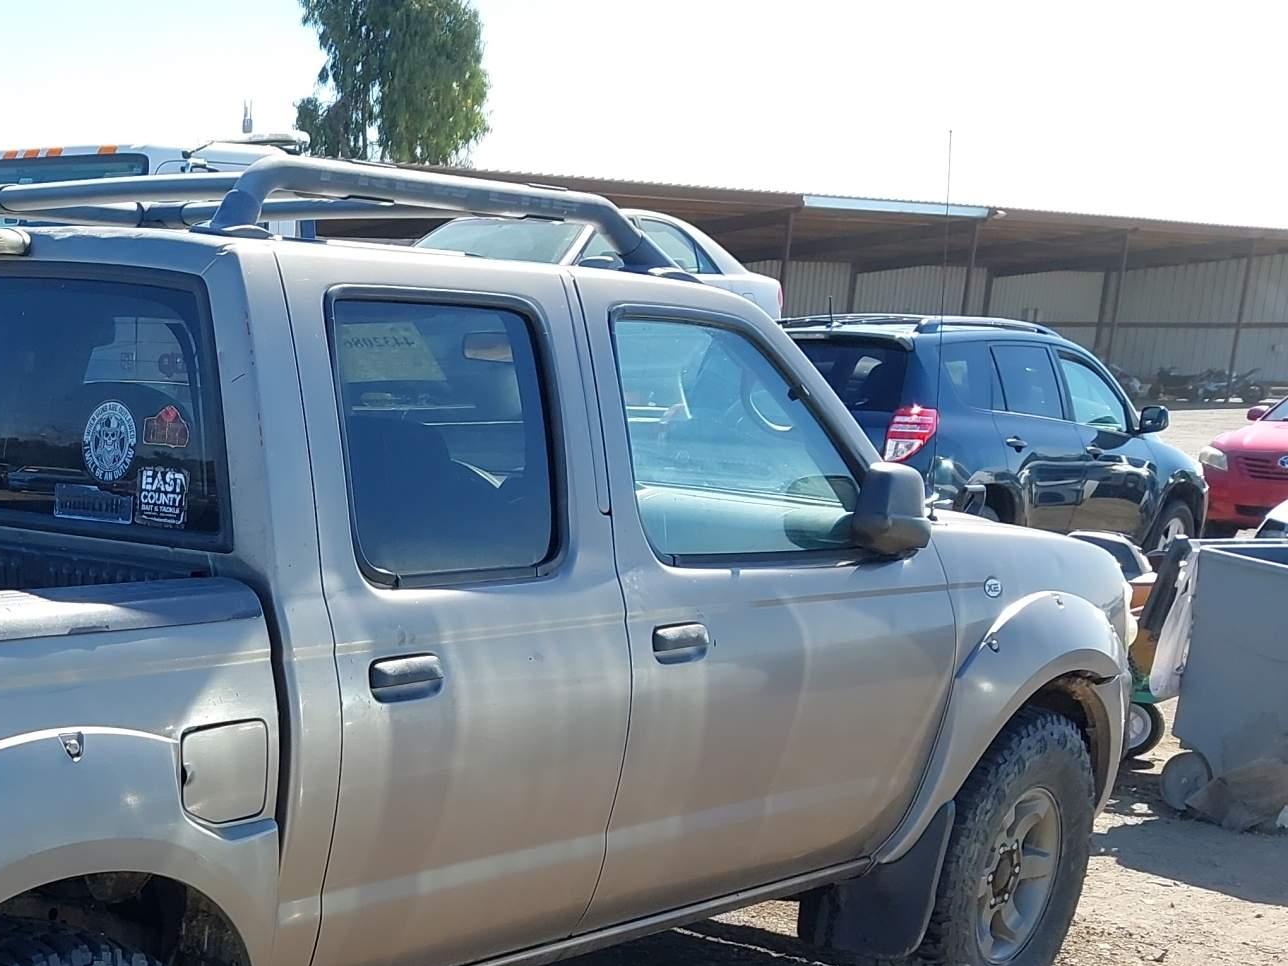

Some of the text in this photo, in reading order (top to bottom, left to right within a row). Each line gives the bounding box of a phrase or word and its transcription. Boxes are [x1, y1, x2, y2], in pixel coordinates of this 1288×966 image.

[103, 471, 113, 481] AN
[113, 447, 134, 479] OUTLAW
[142, 470, 186, 492] EAST
[140, 491, 182, 506] COUNTY
[159, 506, 180, 514] TACKLE
